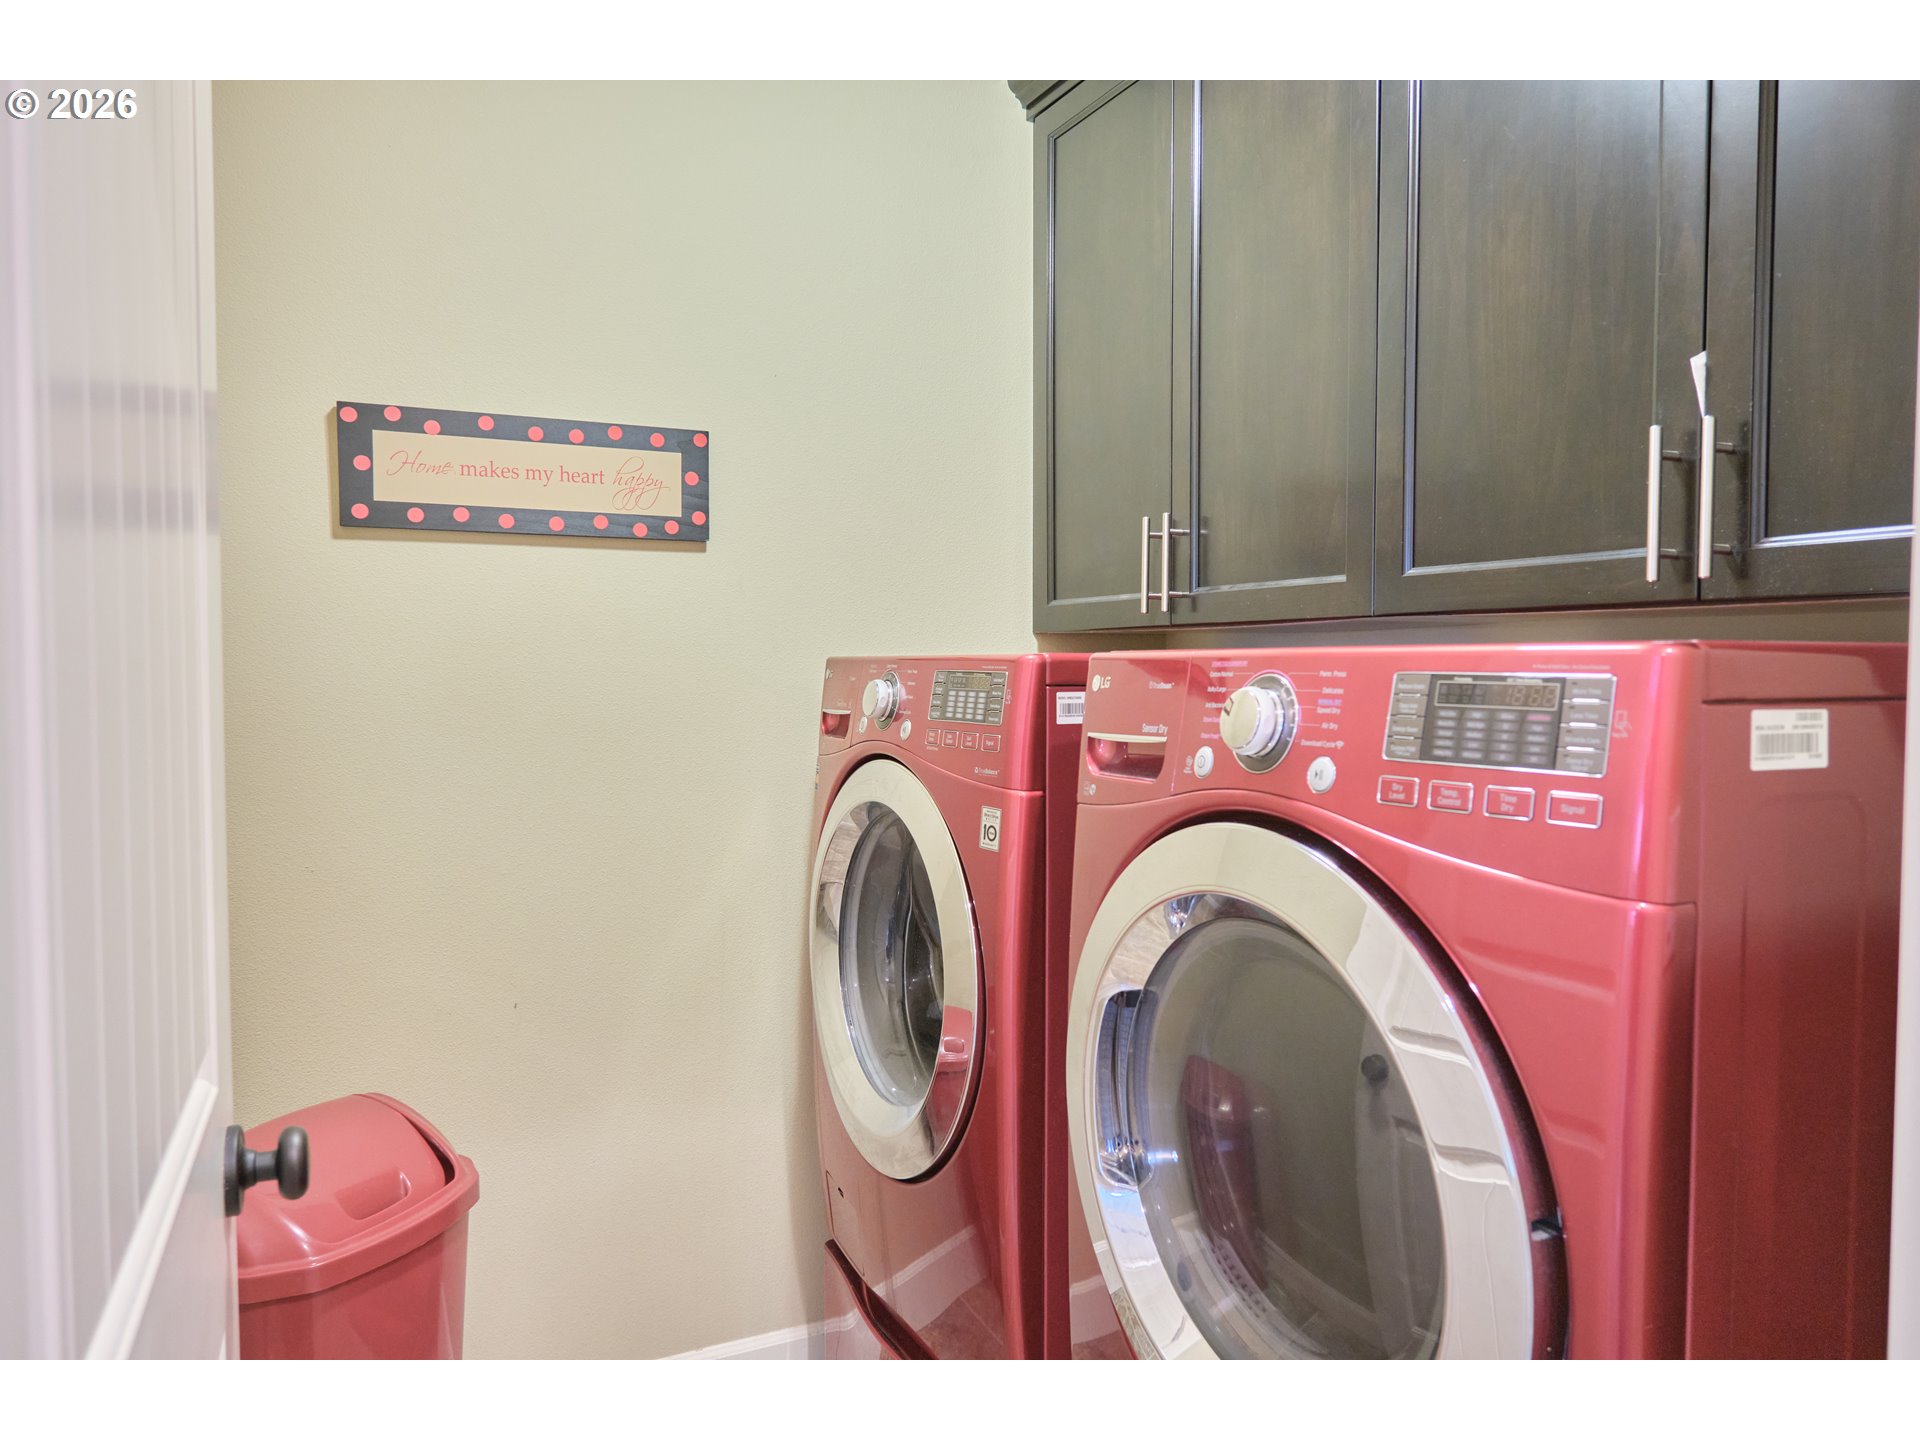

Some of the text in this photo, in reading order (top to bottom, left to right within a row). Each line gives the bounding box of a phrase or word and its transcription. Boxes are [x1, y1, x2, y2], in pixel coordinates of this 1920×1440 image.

[386, 449, 671, 511] Home makes my heart happy
[1560, 803, 1586, 815] Signal
[983, 823, 997, 842] 10
